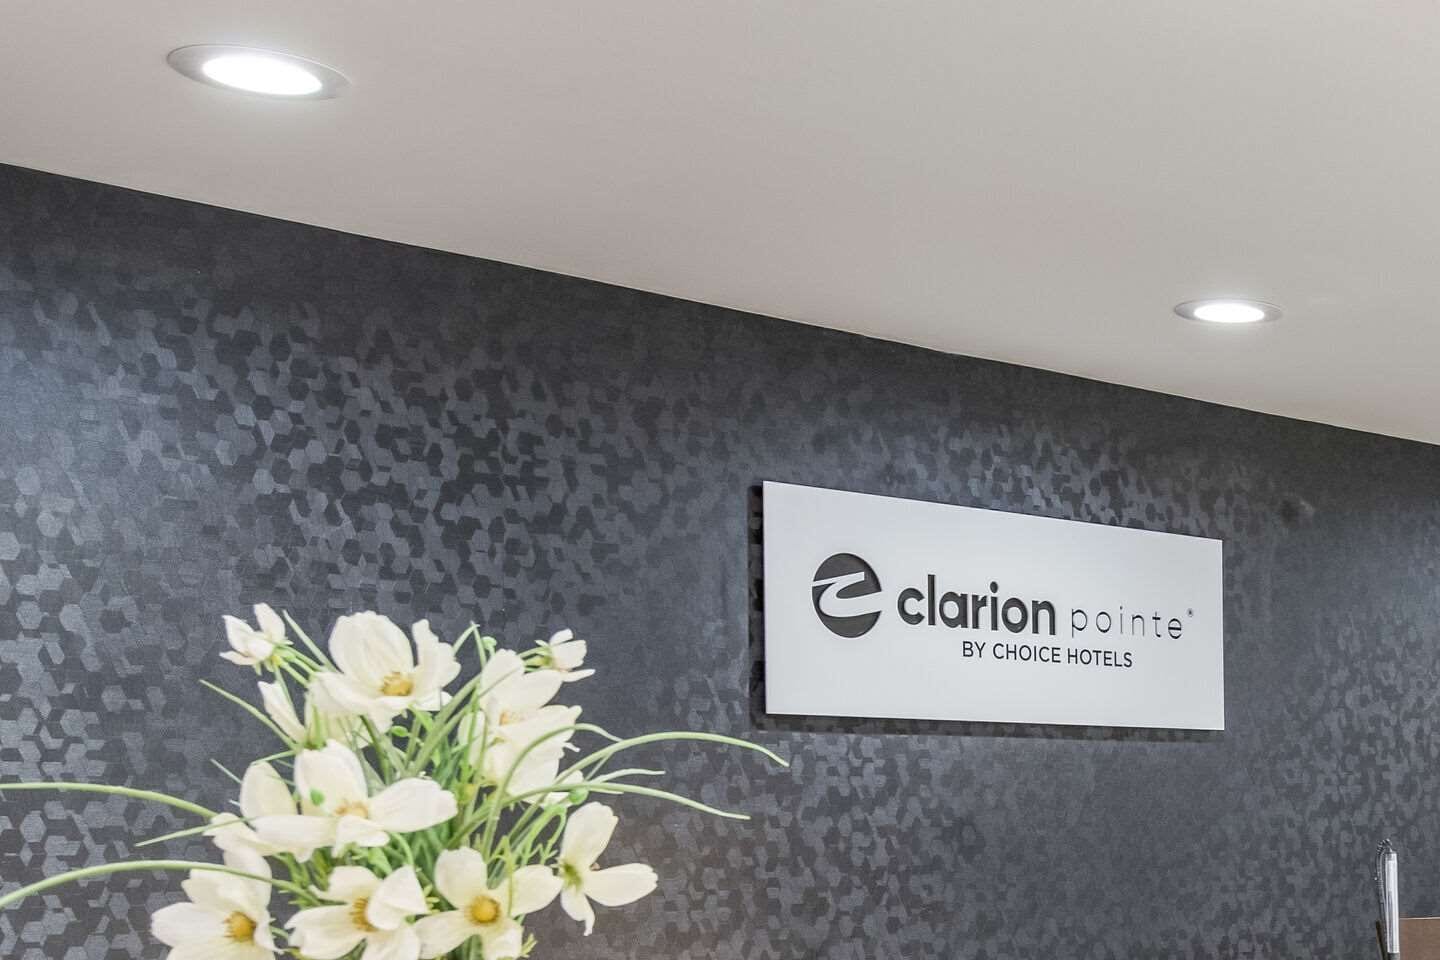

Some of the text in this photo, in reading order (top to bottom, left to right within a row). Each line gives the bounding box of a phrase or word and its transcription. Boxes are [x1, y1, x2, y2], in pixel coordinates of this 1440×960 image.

[897, 574, 1056, 636] clarion
[962, 641, 1133, 668] BY CHOICE HOTELS
